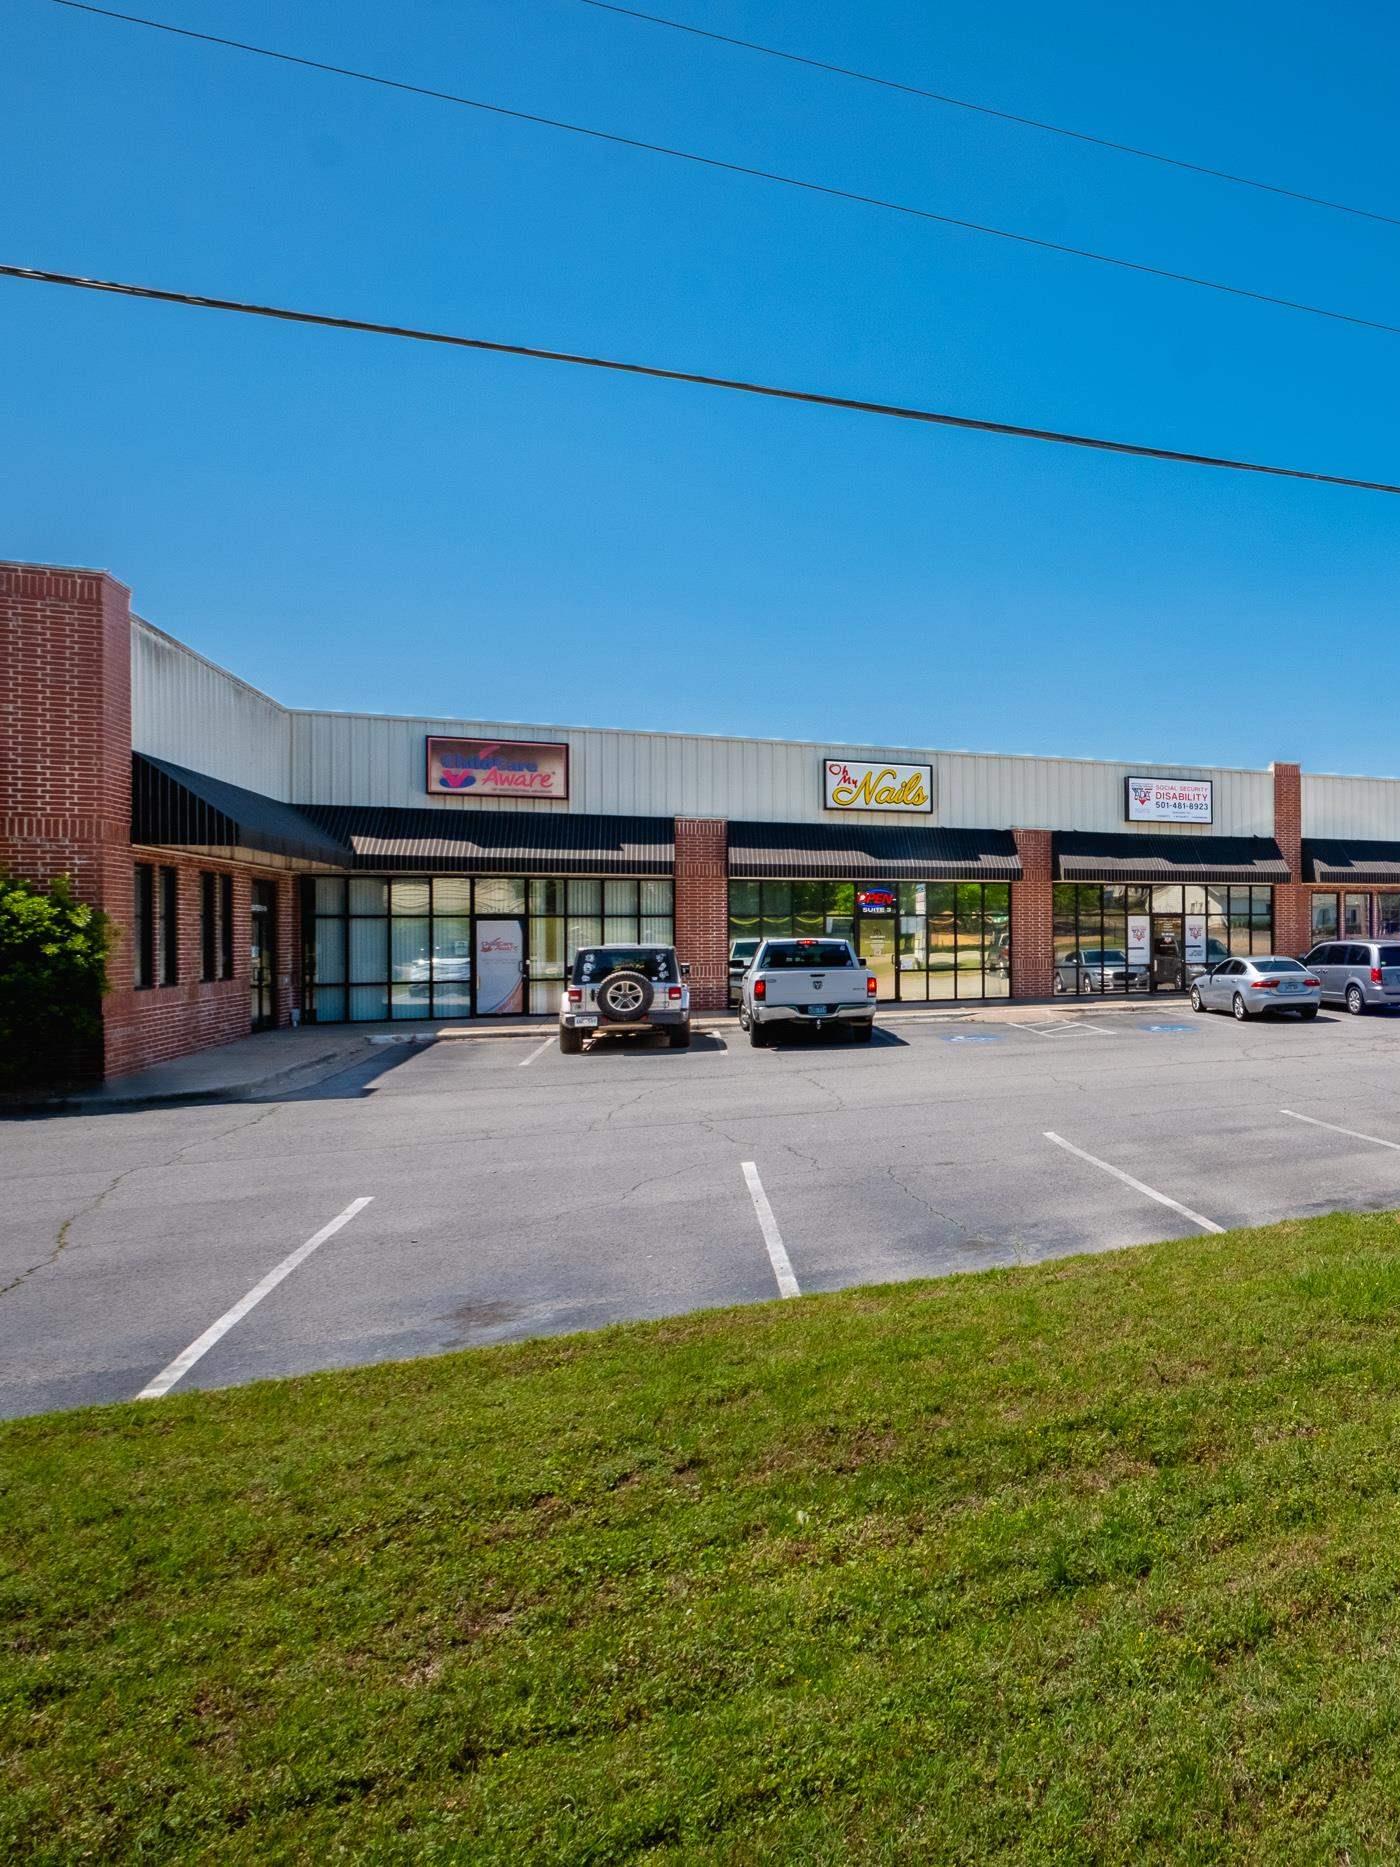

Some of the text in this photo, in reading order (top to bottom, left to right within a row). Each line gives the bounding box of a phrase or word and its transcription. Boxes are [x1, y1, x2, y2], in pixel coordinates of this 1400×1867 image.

[480, 766, 553, 788] Aware
[829, 763, 929, 806] Oh My Nails
[1155, 792, 1208, 801] DISABILITY
[1155, 802, 1209, 810] 501-481-8923
